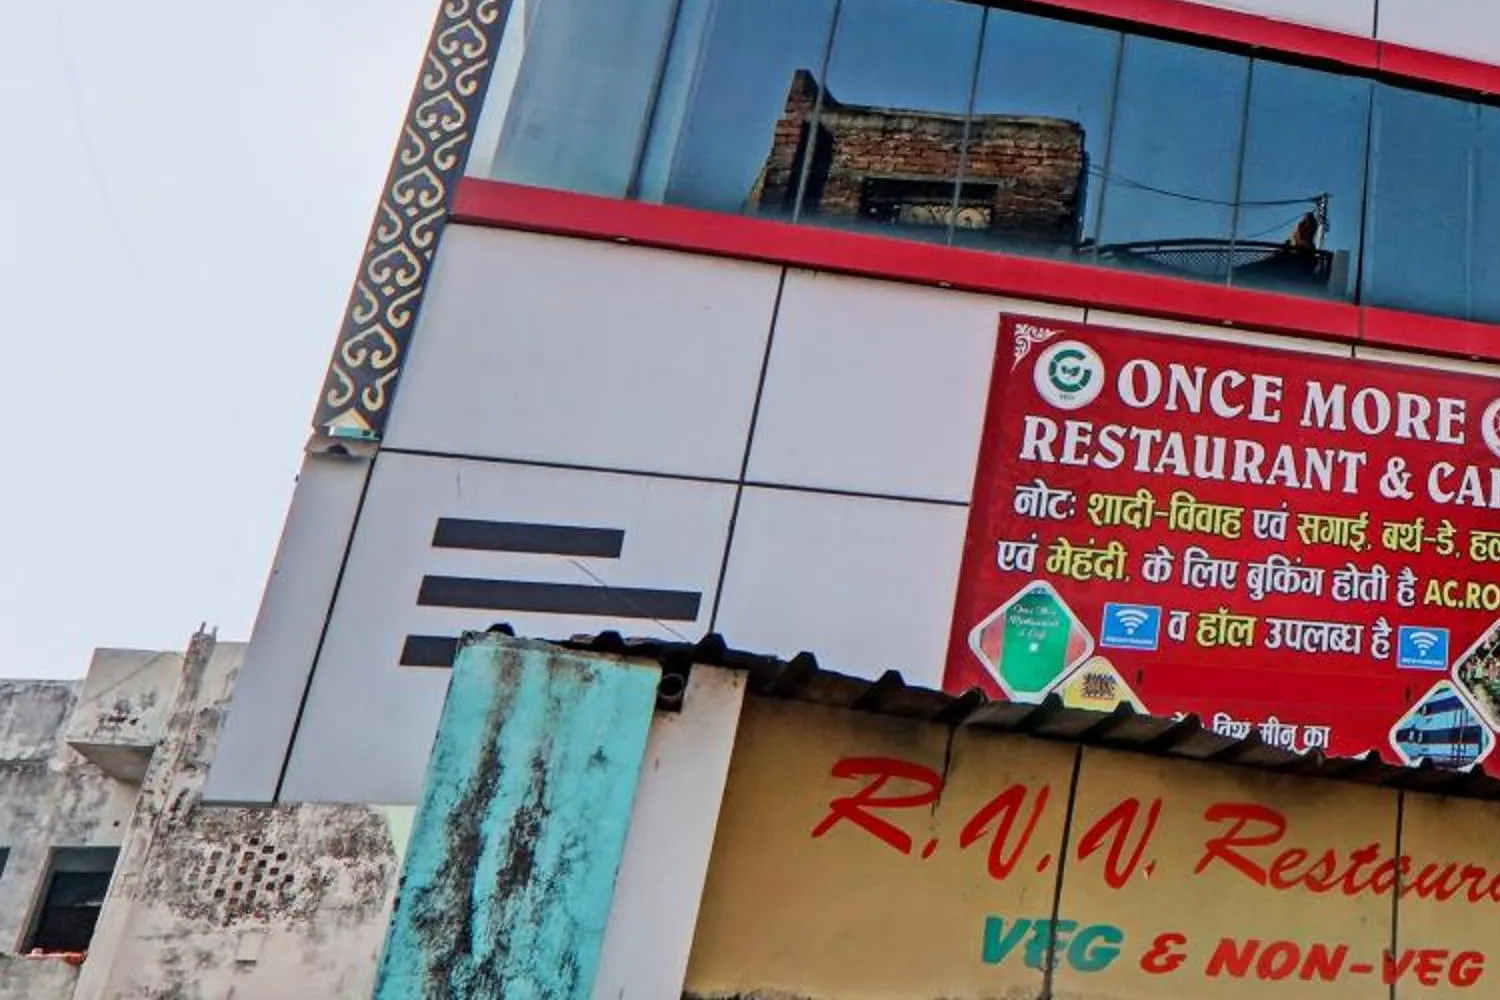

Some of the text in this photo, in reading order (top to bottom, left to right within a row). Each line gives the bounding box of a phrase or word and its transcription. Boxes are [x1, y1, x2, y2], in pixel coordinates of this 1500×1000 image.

[1117, 358, 1466, 445] ONCE MORE
[1019, 415, 1367, 494] RESTAURANT
[1379, 456, 1415, 501] &
[1253, 502, 1289, 540] एवं
[997, 532, 1039, 573] एवं
[1141, 545, 1174, 583] के
[1182, 546, 1239, 590] लिए
[1246, 554, 1326, 600] बुकिंग
[1332, 562, 1390, 601] होती
[1396, 567, 1418, 608] है
[1168, 609, 1190, 642] व
[1264, 617, 1364, 655] उपलब्ध
[1371, 616, 1394, 661] है
[982, 915, 1486, 988] VEG & NON-VEG
